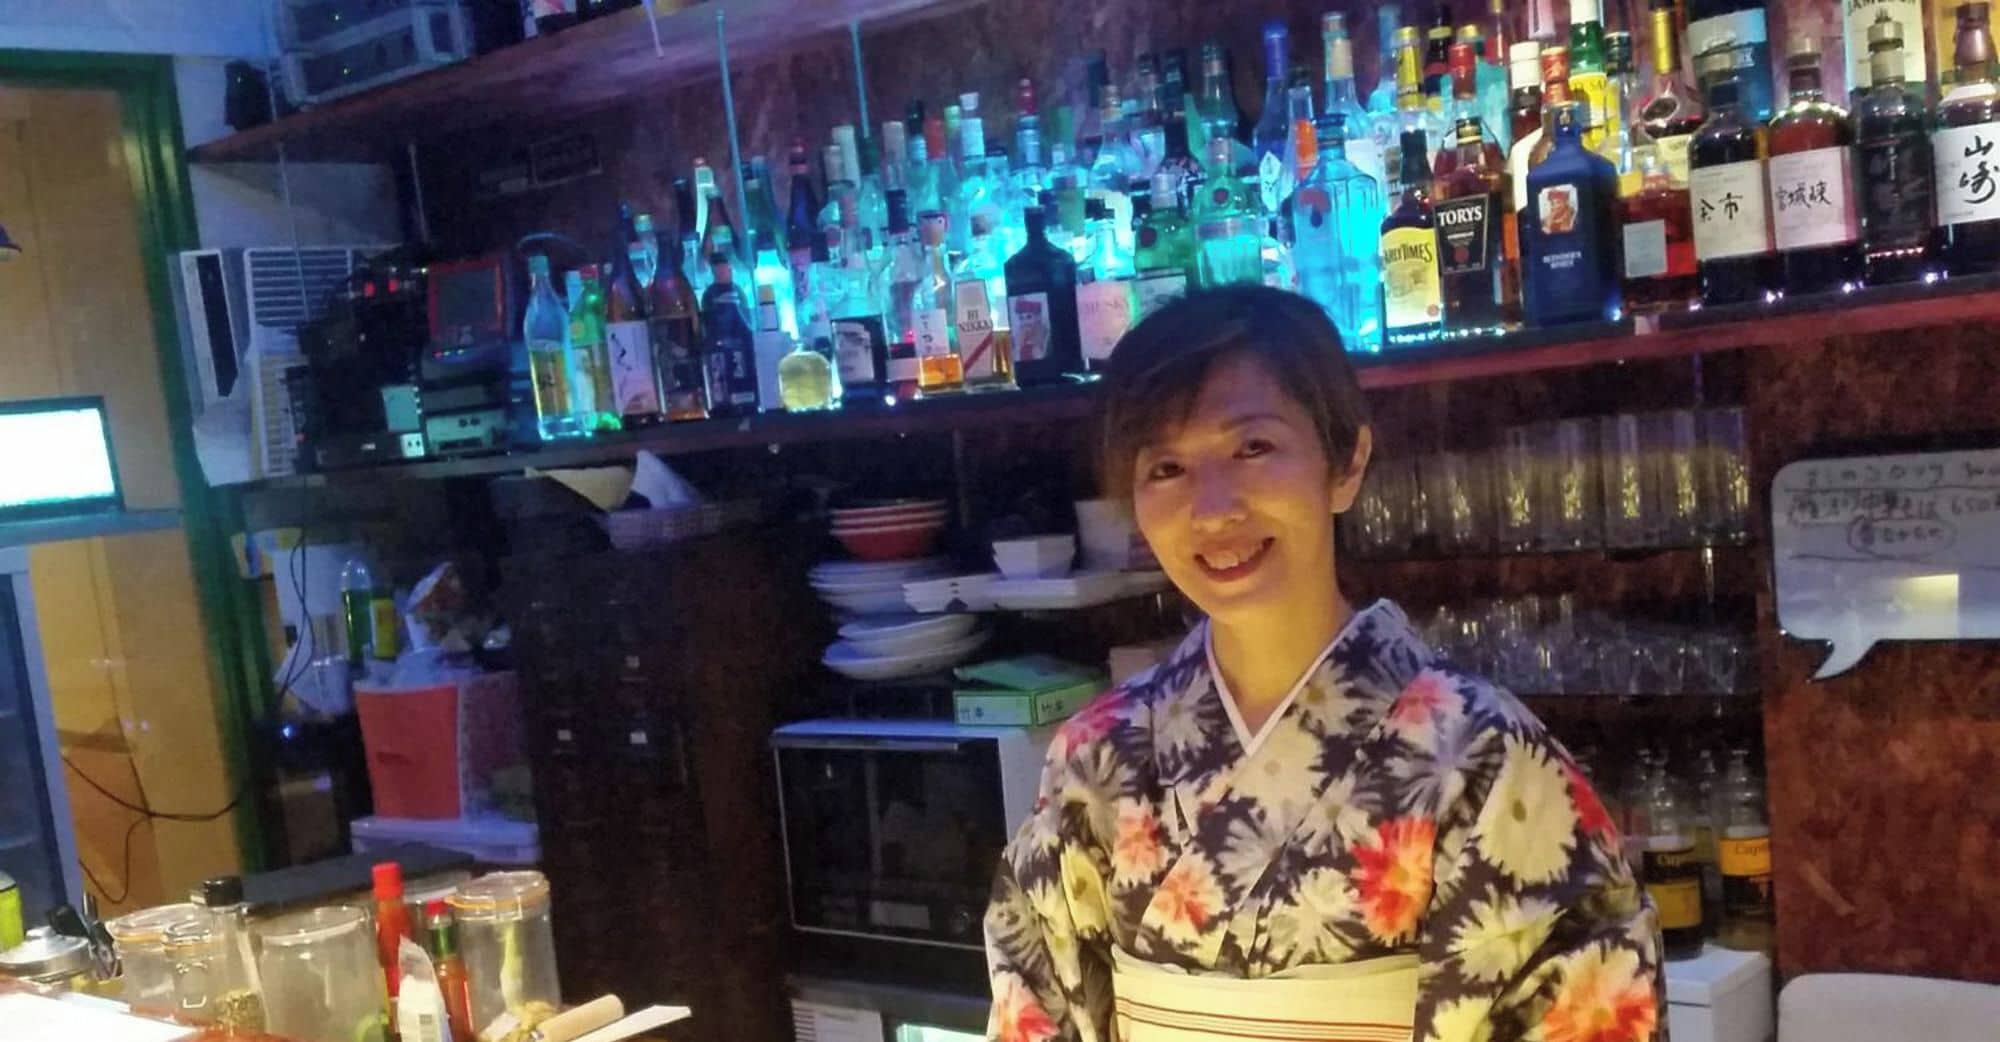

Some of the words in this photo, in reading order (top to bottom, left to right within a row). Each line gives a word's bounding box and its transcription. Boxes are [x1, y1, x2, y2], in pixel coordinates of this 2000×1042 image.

[1959, 135, 2000, 204] 山崎
[1437, 206, 1483, 227] TORYS
[1699, 192, 1743, 222] 余市
[1400, 243, 1433, 263] TIMES
[967, 309, 979, 321] HI
